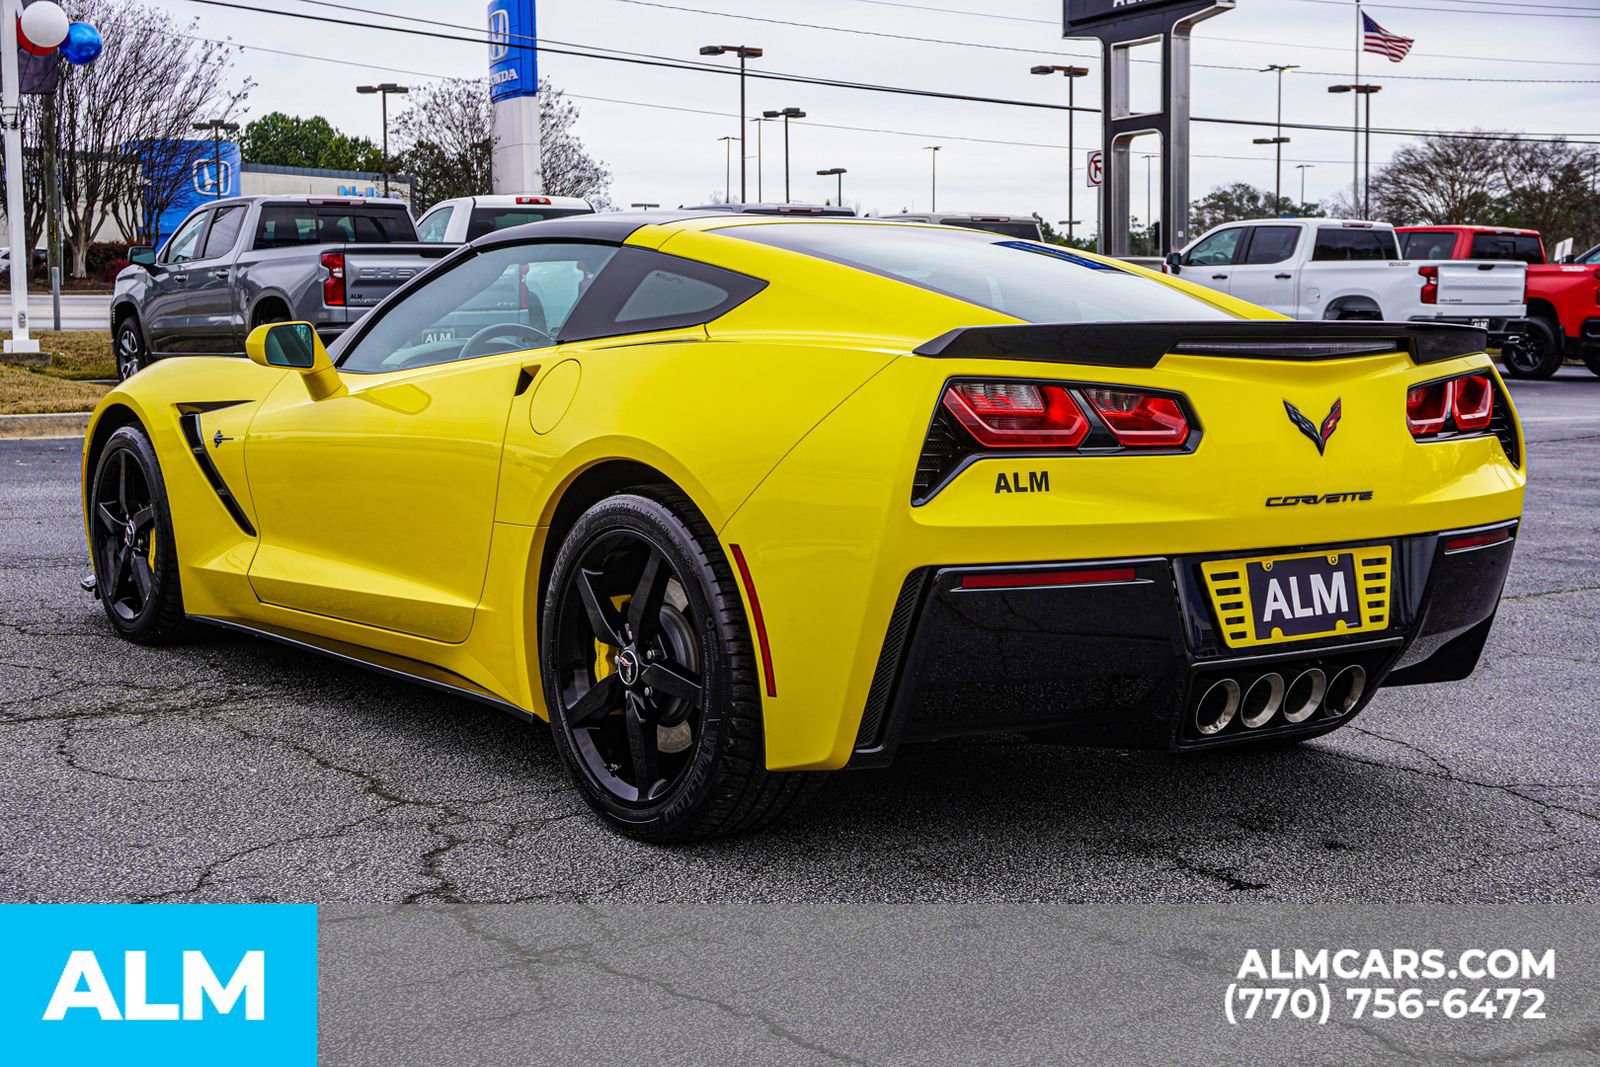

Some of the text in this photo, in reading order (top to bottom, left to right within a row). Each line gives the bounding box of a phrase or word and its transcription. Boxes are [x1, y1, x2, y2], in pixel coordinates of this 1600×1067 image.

[994, 470, 1050, 494] ALM
[1264, 490, 1375, 508] CORVETTE
[1263, 570, 1349, 623] ALM
